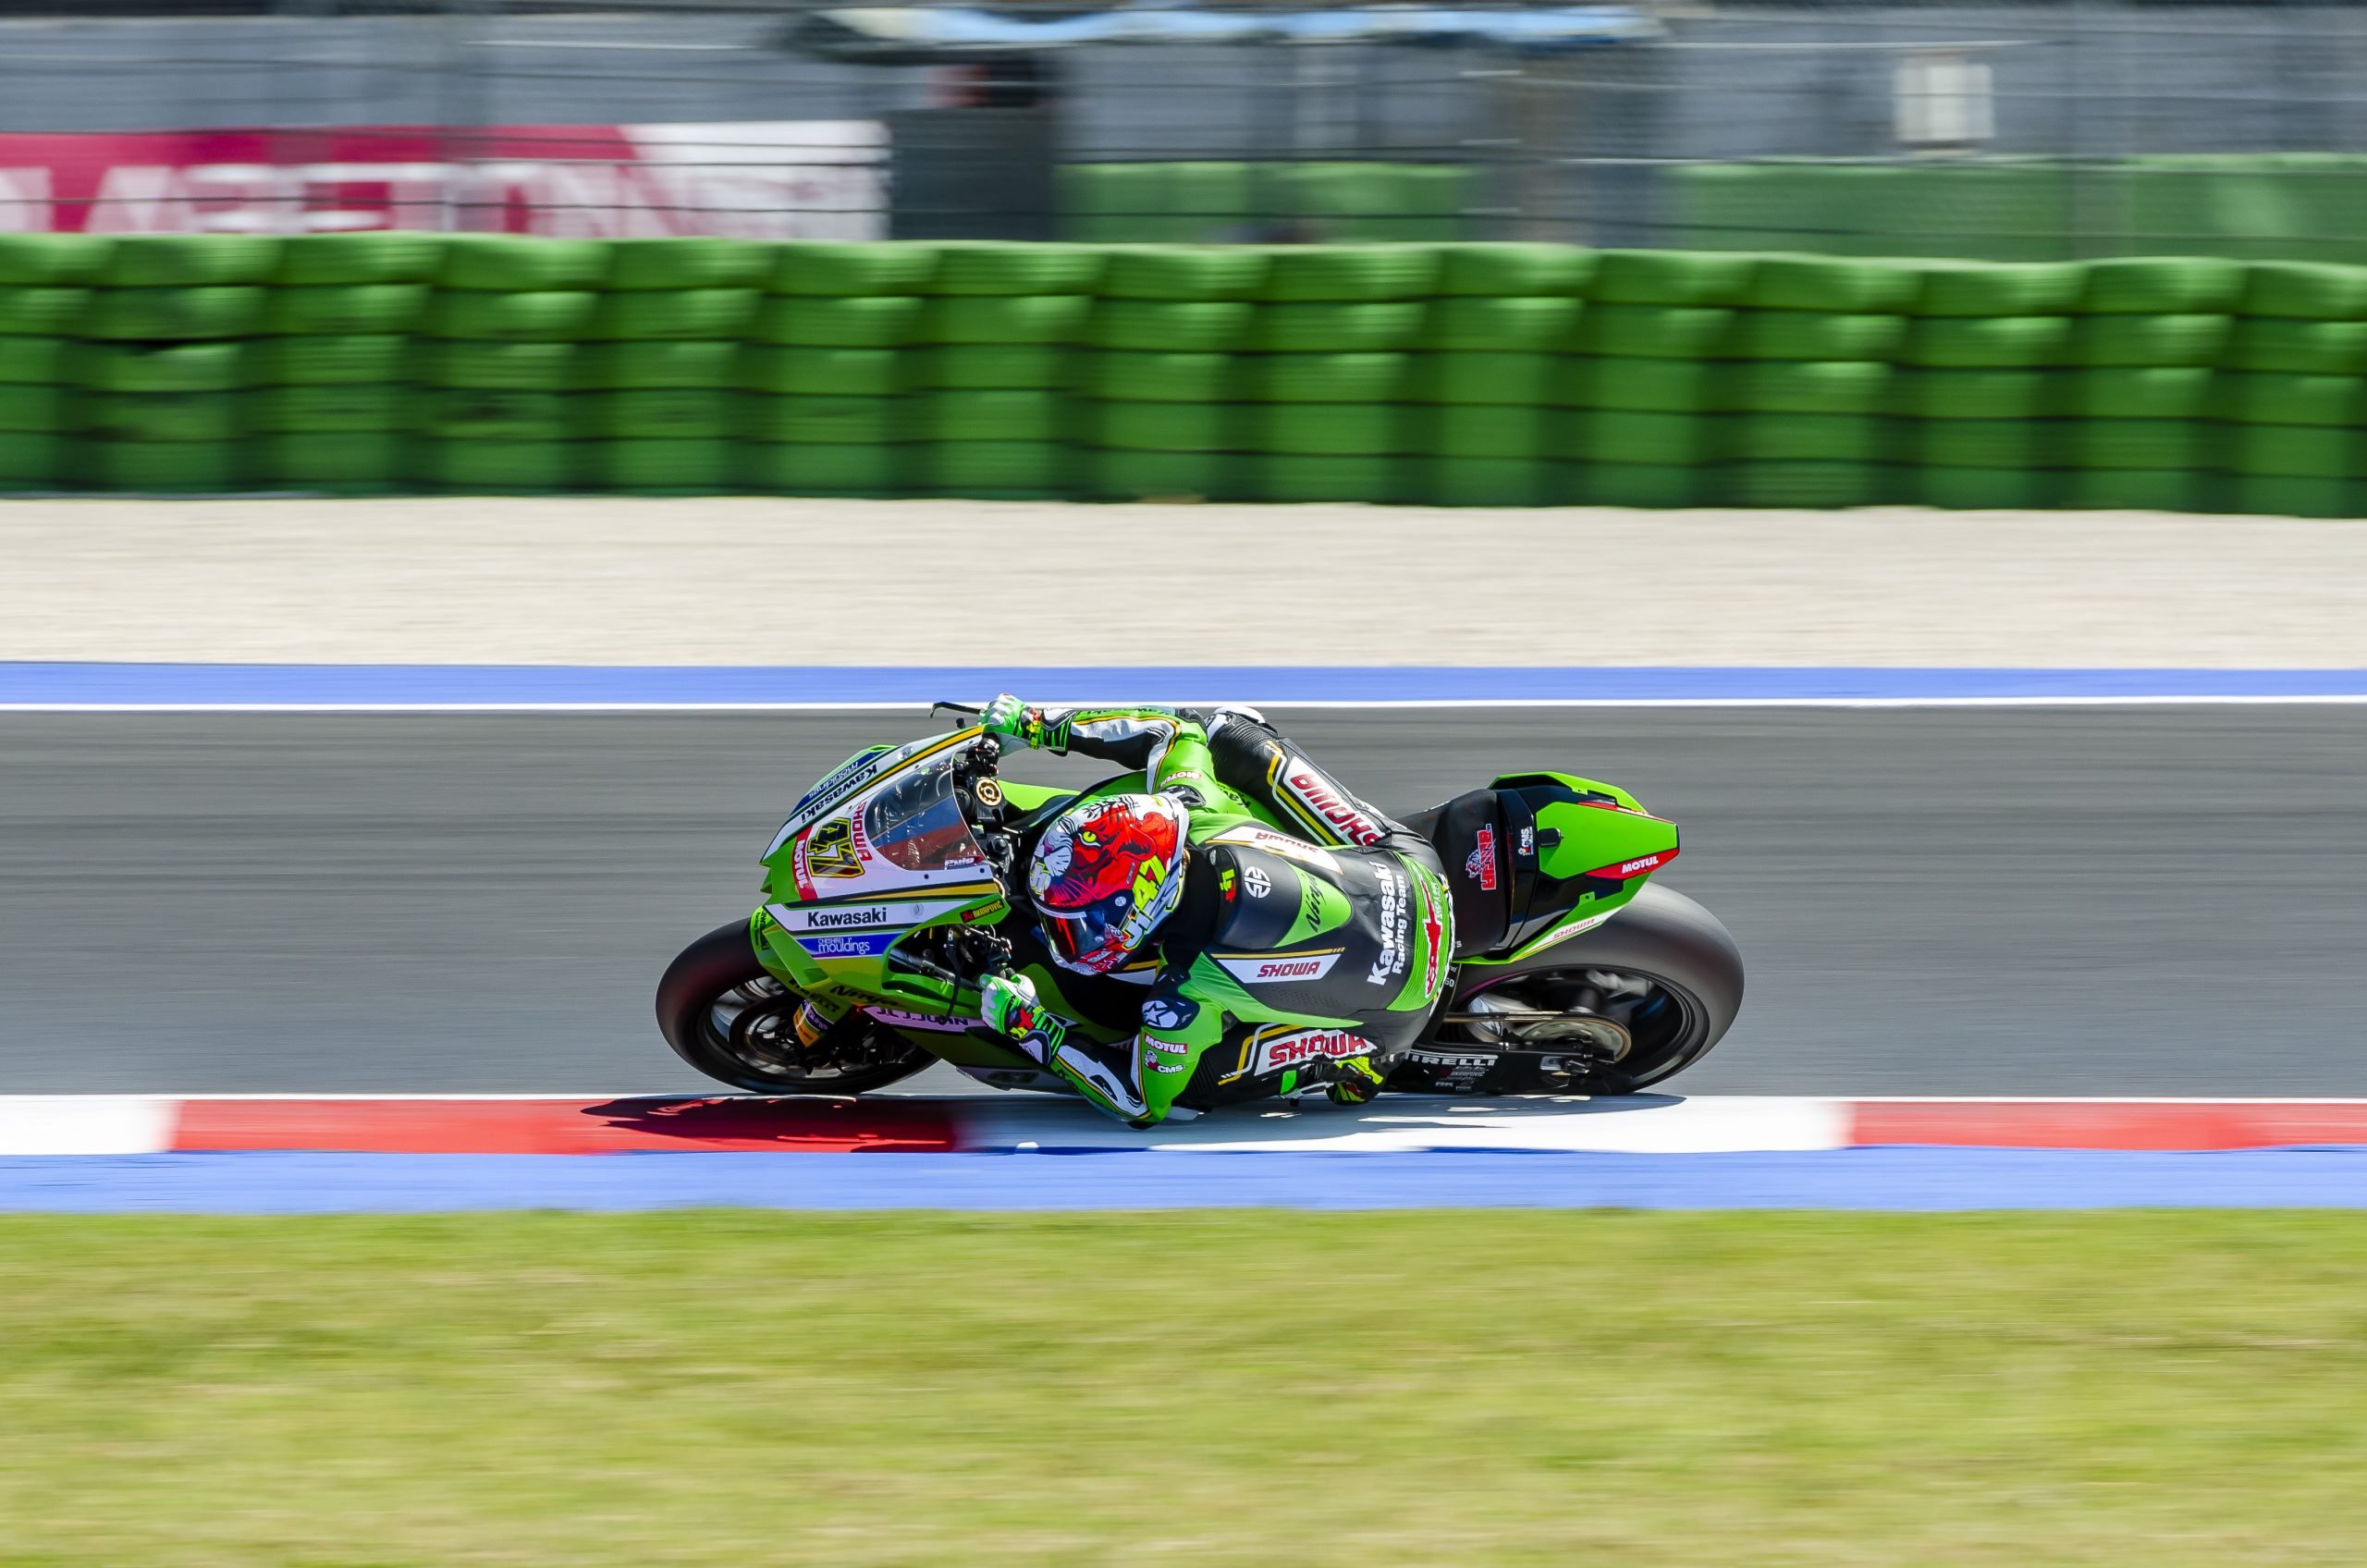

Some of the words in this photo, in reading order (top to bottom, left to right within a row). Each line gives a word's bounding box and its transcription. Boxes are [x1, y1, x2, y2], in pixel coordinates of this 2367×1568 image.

[801, 764, 877, 824] Kawasaki
[1290, 773, 1381, 847] SHOWA
[806, 816, 865, 878] 47
[851, 801, 873, 861] SHOWA
[794, 839, 808, 889] MOTUL
[1621, 855, 1660, 875] MOTUL
[1396, 874, 1406, 916] Team
[807, 907, 888, 927] Kawasaki
[1367, 861, 1396, 986] Kawasaki
[1552, 918, 1595, 939] SHOWA
[818, 937, 870, 955] mouldings
[1392, 918, 1407, 974] Racing
[1257, 961, 1321, 978] SHOWA
[1145, 1035, 1186, 1054] MOTUL
[1269, 1033, 1367, 1067] SHOWA
[1404, 1049, 1499, 1067] PIRELLI
[1158, 1064, 1184, 1073] CMS
